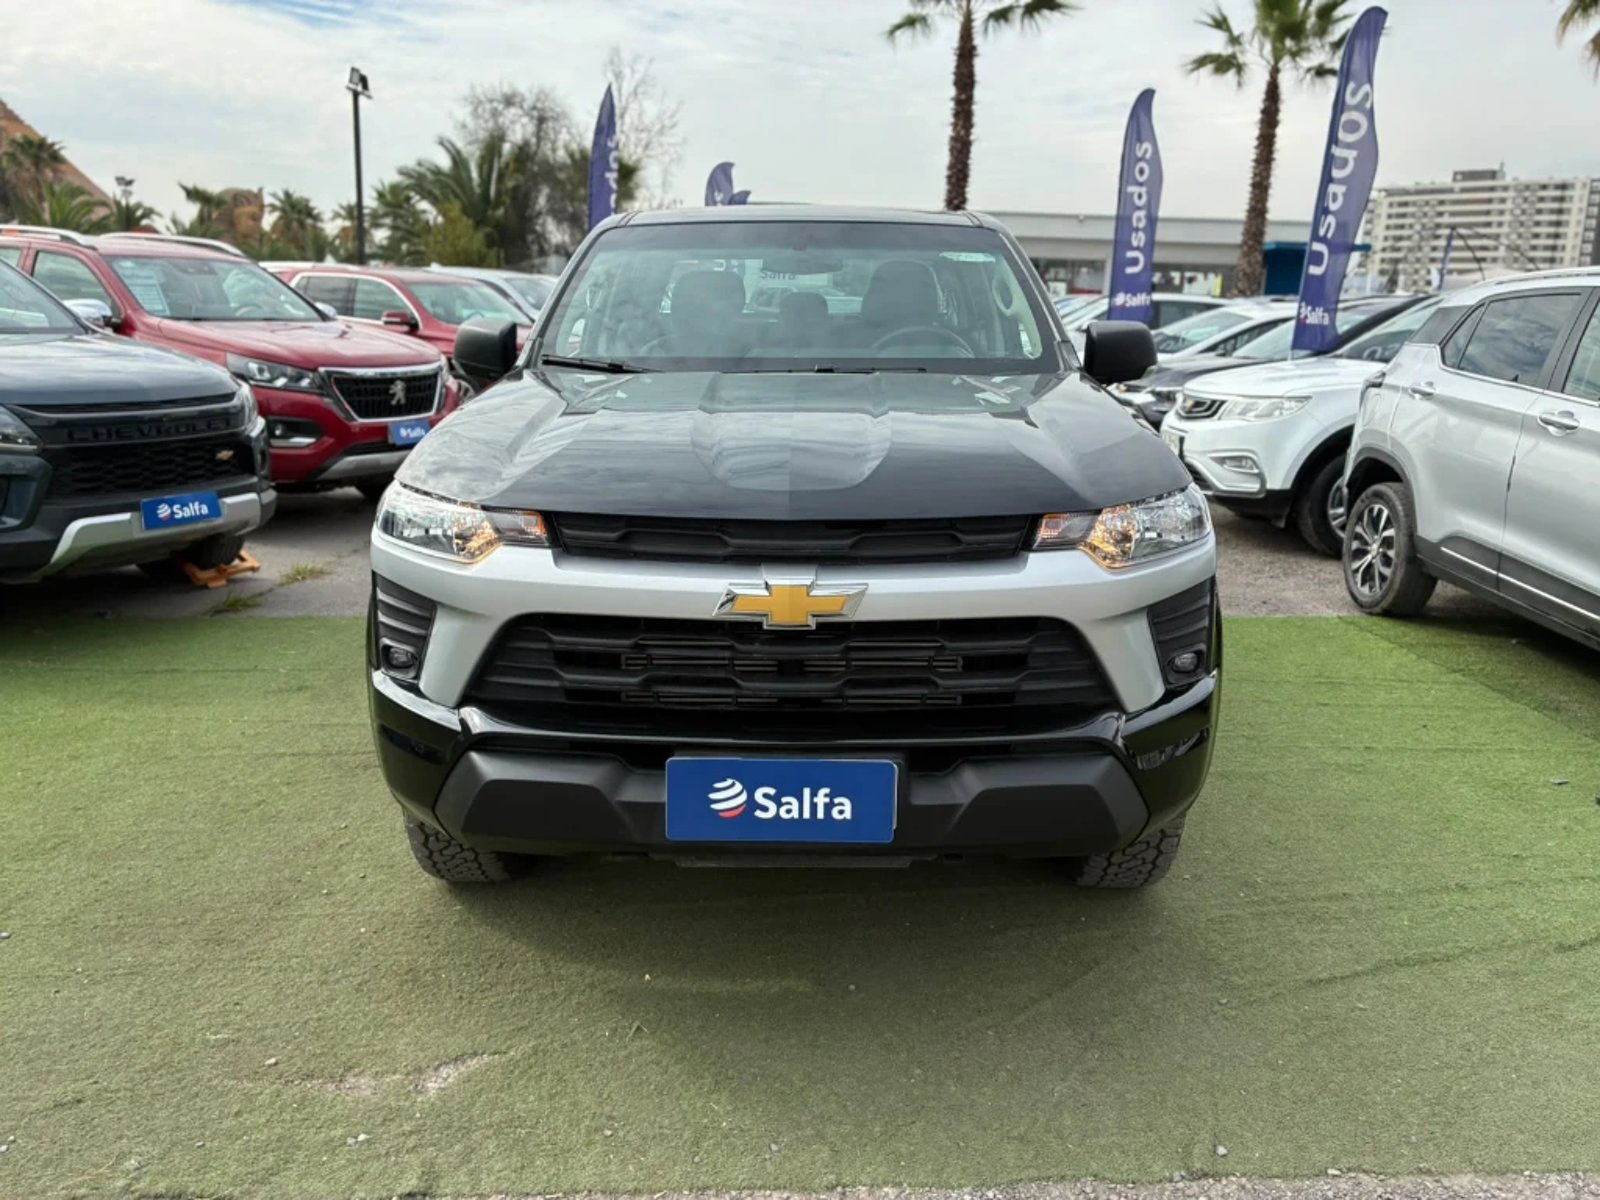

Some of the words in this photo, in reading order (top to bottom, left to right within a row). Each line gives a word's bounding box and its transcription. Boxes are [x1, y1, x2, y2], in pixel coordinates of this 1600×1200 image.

[1308, 81, 1374, 276] Usados
[1125, 141, 1152, 275] Usados
[1305, 307, 1330, 326] Salfa
[68, 417, 234, 442] CHEVROLET
[172, 502, 209, 519] Salfa
[754, 786, 852, 820] Salfa
